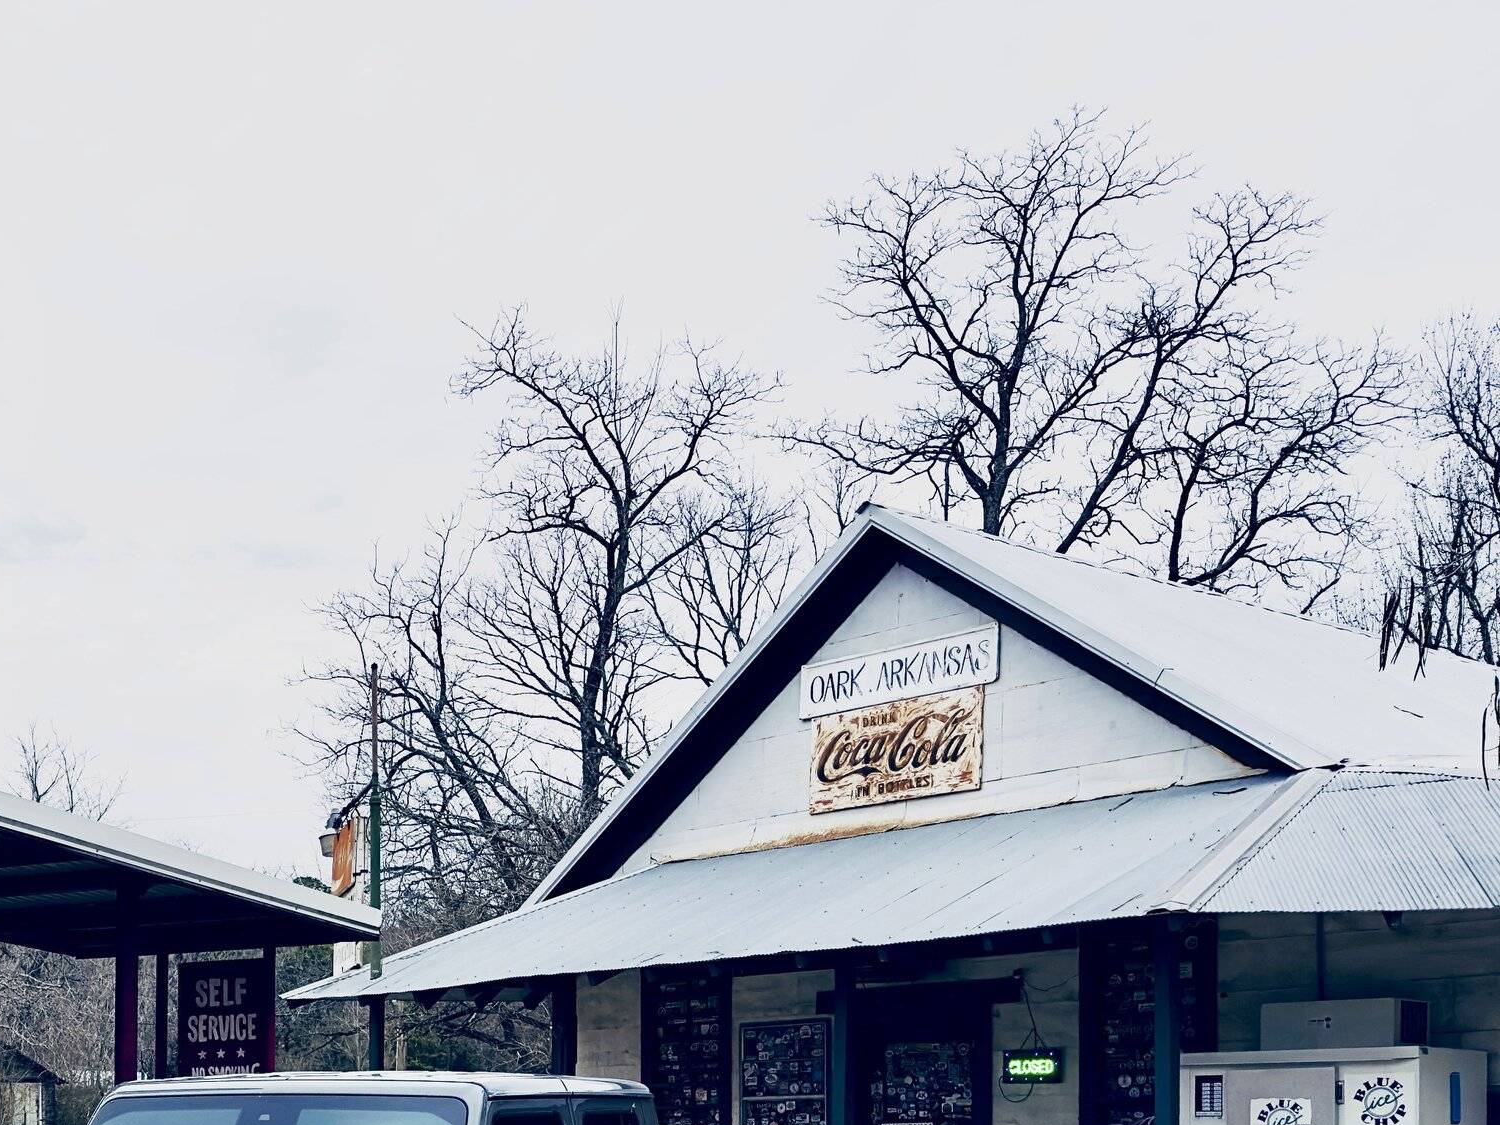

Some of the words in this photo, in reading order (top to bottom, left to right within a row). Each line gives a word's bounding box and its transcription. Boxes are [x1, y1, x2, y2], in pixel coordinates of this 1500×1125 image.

[876, 639, 990, 692] ARKANSAS
[195, 978, 247, 1008] SELF
[187, 1013, 257, 1043] SERVICE
[1008, 1059, 1055, 1076] CLOSED
[1353, 1077, 1404, 1102] BLUE
[1257, 1099, 1303, 1123] BLUE
